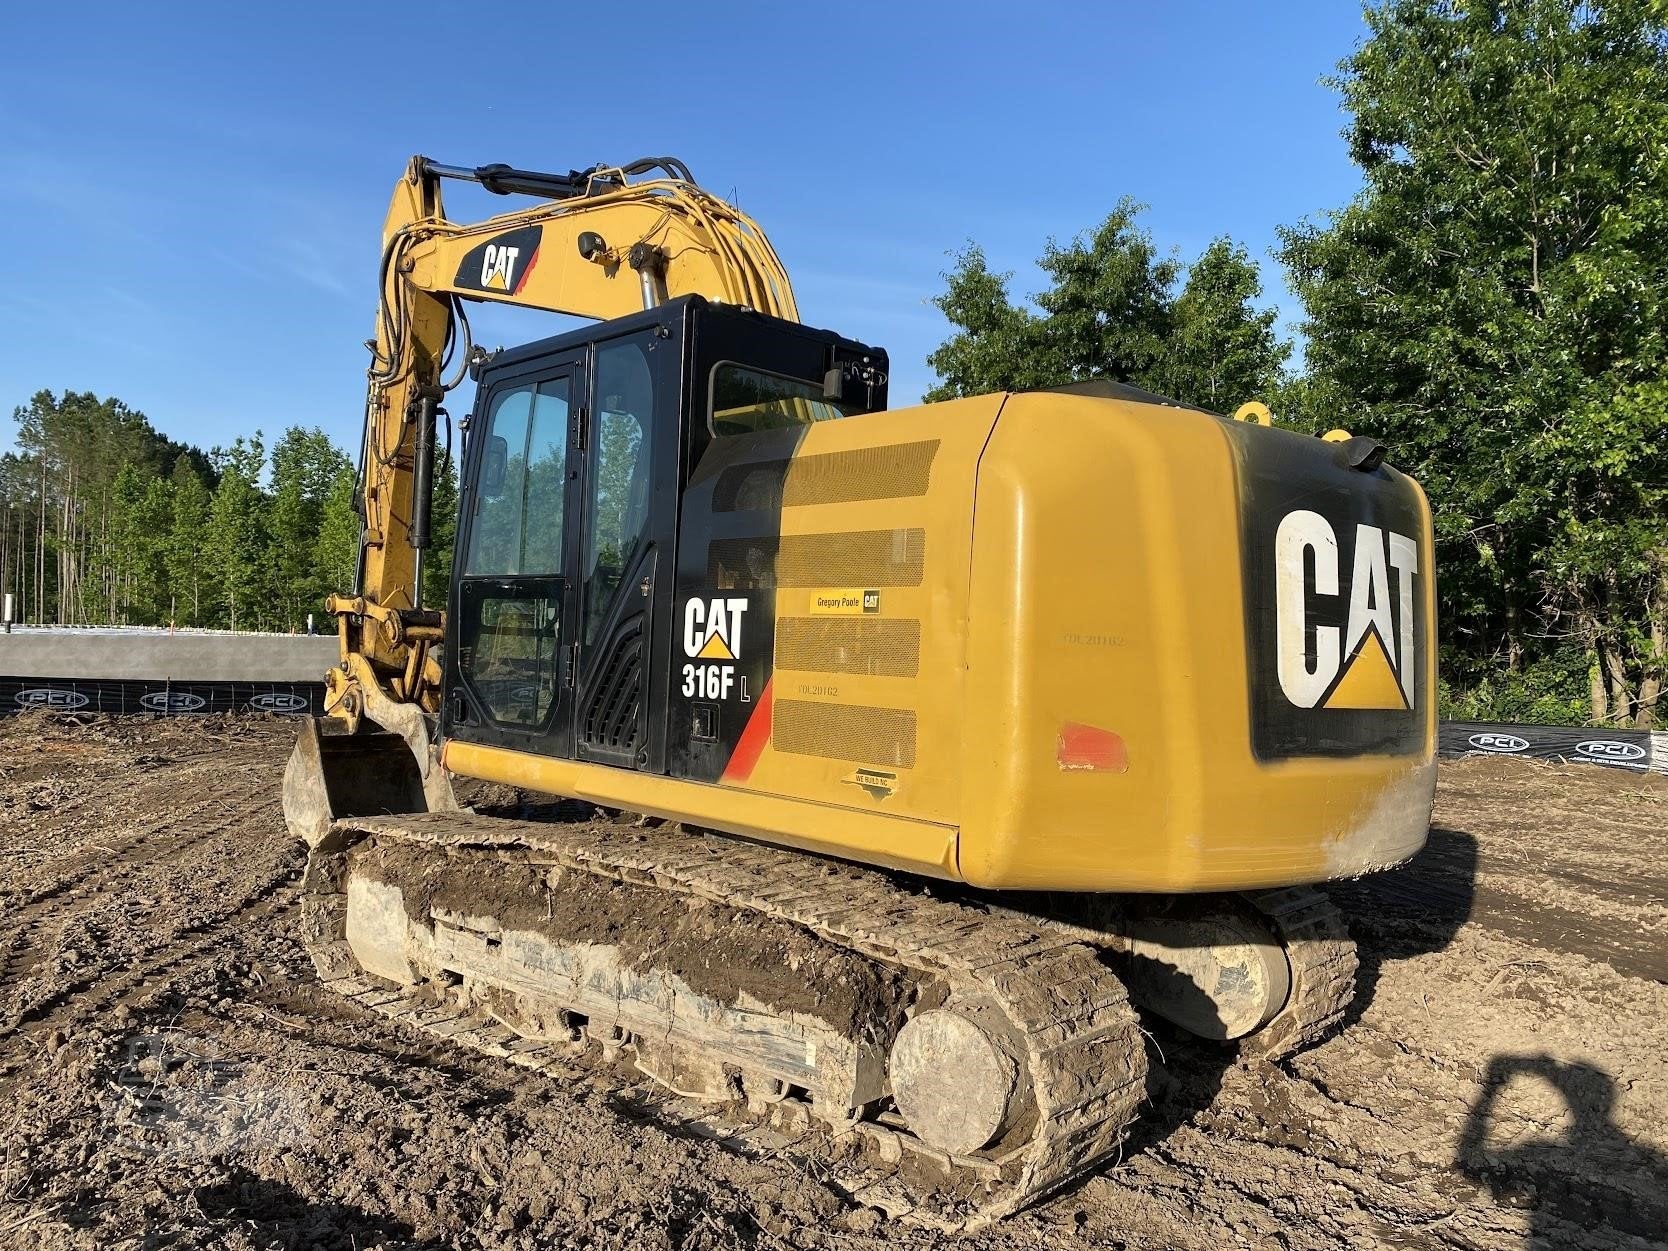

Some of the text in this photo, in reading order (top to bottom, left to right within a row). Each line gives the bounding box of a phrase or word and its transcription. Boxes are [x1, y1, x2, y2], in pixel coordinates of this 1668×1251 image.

[480, 244, 520, 291] CAT
[817, 595, 879, 609] Gregory Poole CAT
[1275, 509, 1418, 710] CAT
[683, 597, 749, 660] CAT
[681, 663, 751, 703] 316F L
[152, 696, 190, 707] PCI
[260, 697, 294, 707] PCI
[1479, 736, 1518, 748] PCI
[1588, 744, 1632, 756] PCI
[856, 775, 864, 783] WE
